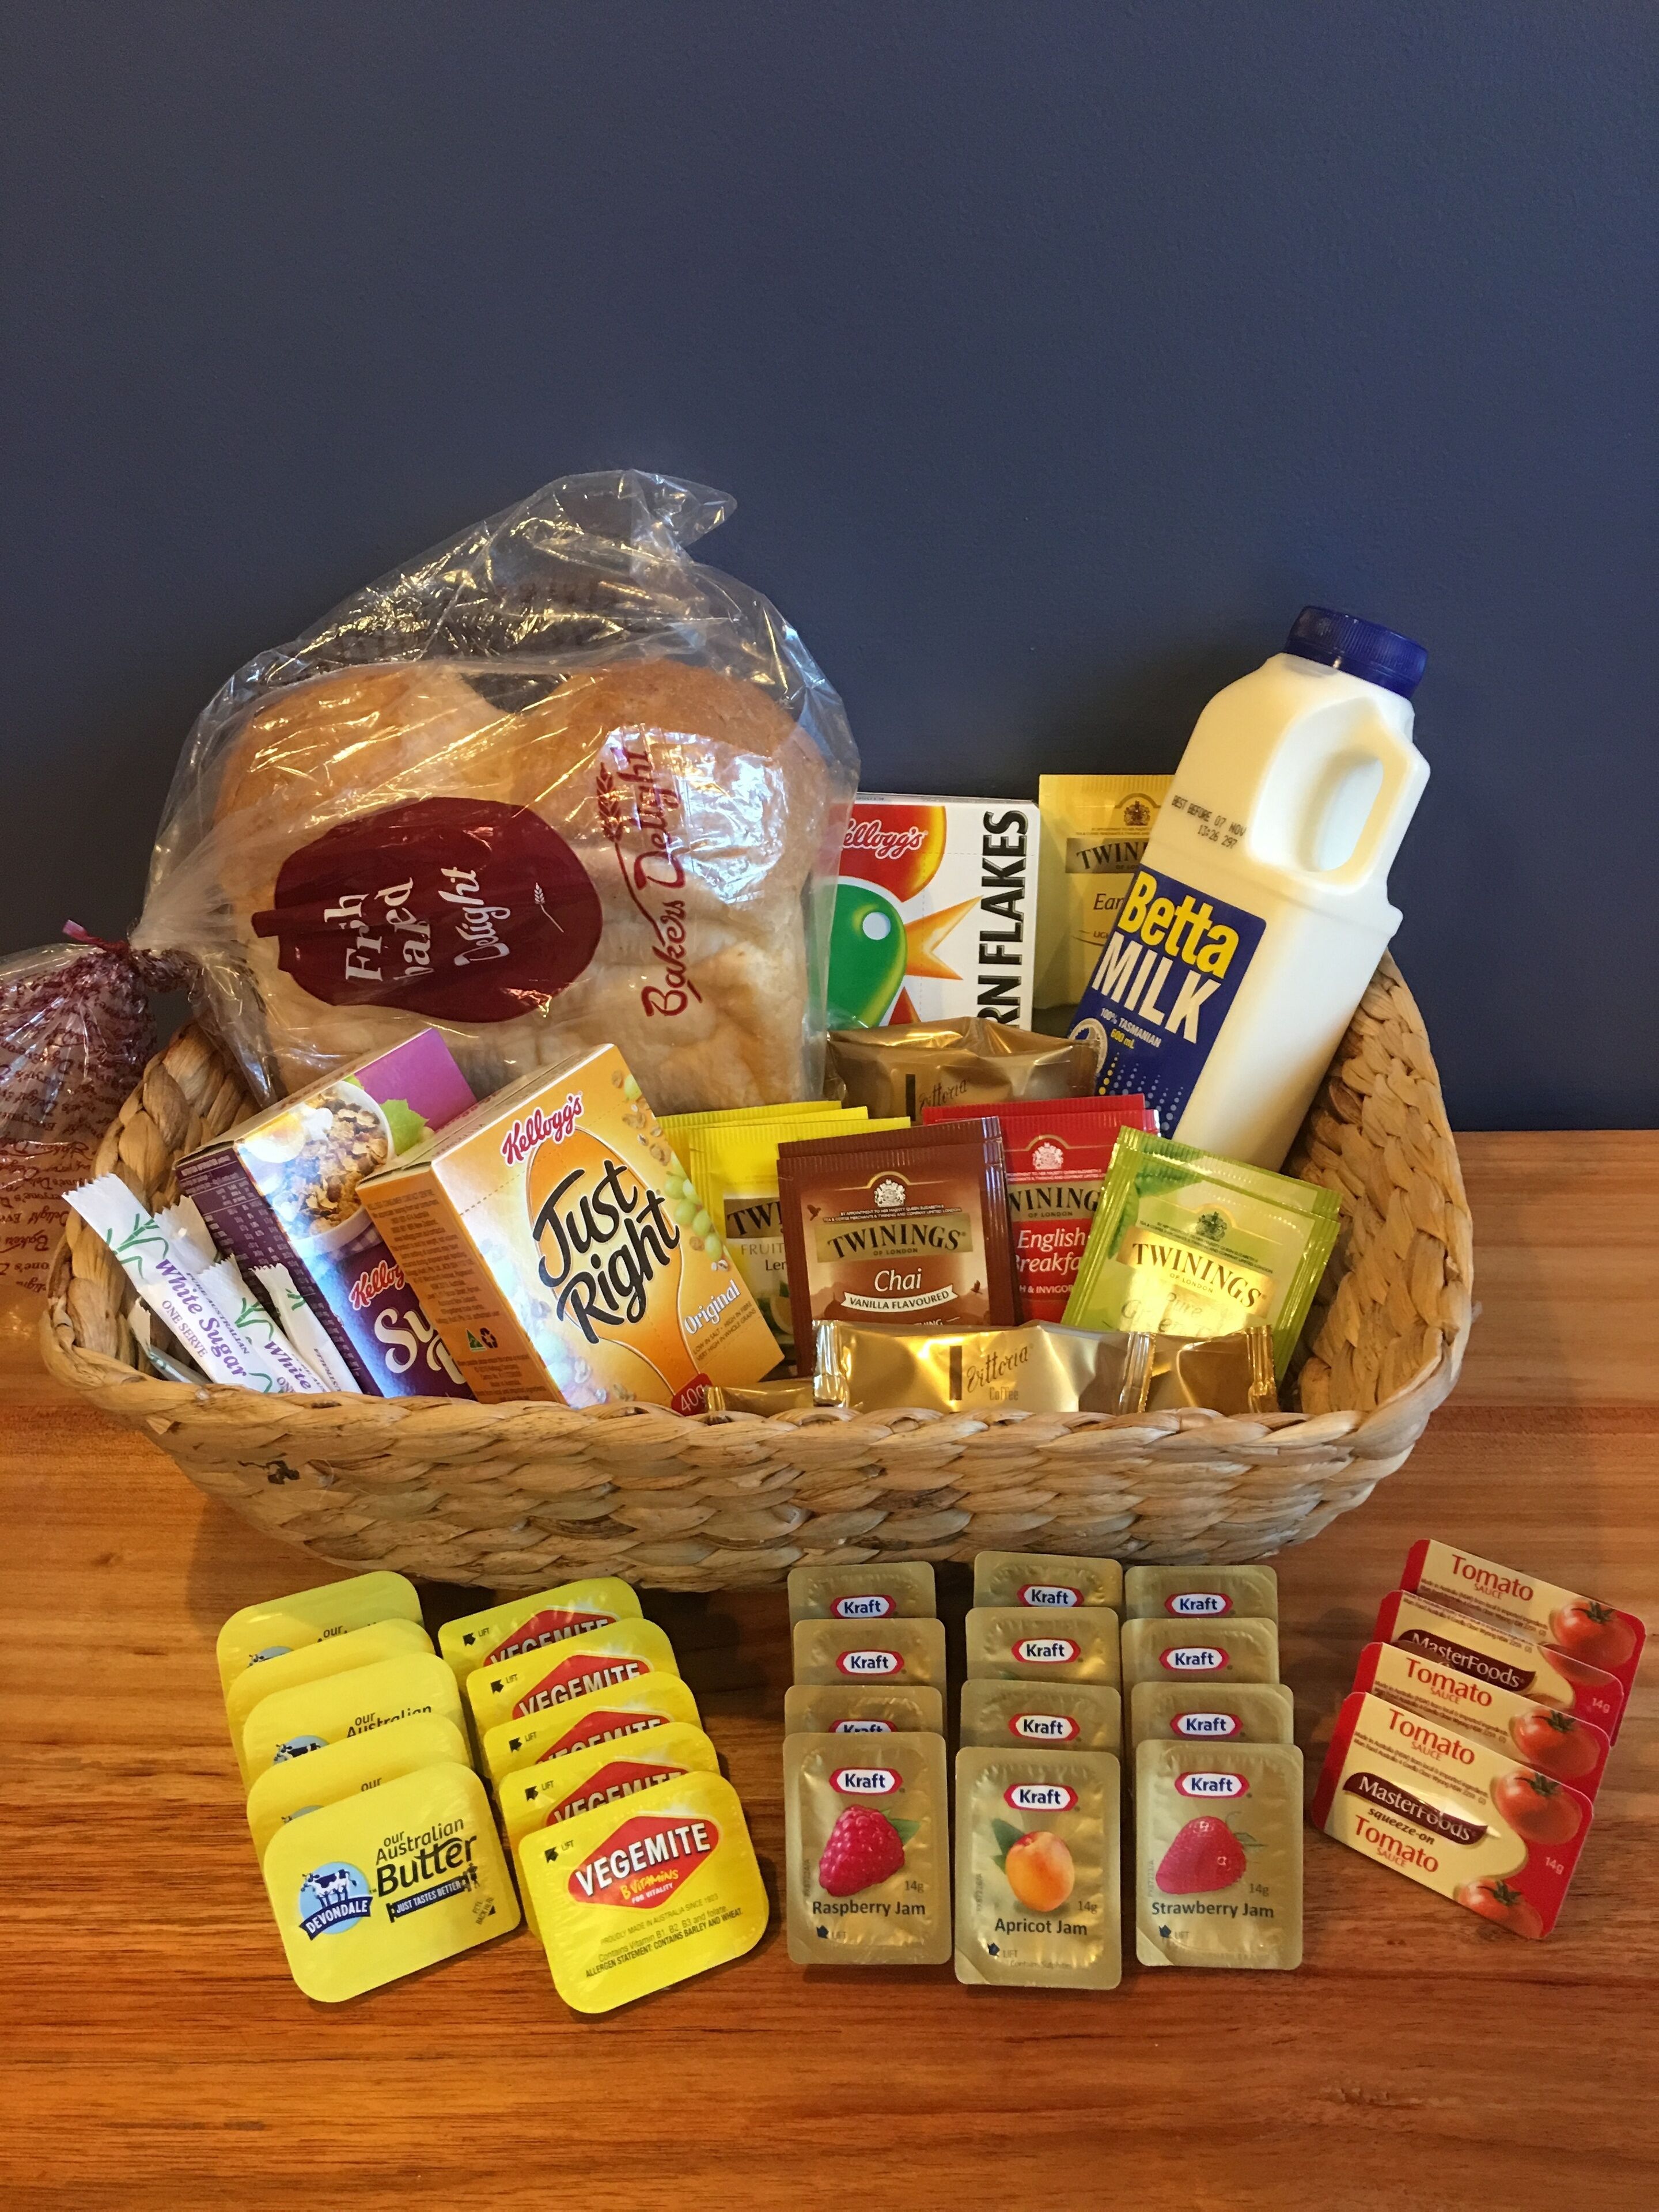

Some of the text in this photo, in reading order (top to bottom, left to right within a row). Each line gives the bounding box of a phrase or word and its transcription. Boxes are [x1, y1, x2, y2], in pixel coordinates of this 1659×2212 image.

[1172, 794, 1186, 809] BEST
[1187, 804, 1213, 823] BEFORE
[1214, 815, 1225, 827] 07
[843, 818, 925, 859] ellogg's
[611, 747, 694, 1016] Bakers Delight
[980, 809, 1029, 965] FLAKES
[438, 865, 510, 966] Delight
[1118, 870, 1240, 979] Betta
[324, 893, 382, 982] Frh
[1092, 933, 1221, 1044] MILK
[1101, 1008, 1162, 1048] 100% TASMANIAN
[501, 1093, 583, 1166] Kellogg's
[533, 1159, 638, 1287] Just
[741, 1242, 785, 1255] FRUIT
[828, 1224, 961, 1258] TWININGS
[1018, 1227, 1086, 1252] English
[557, 1189, 680, 1344] Right
[1132, 1243, 1262, 1308] TWININGS
[874, 1268, 922, 1291] Chai
[1182, 1277, 1213, 1293] LONDON
[683, 1279, 741, 1335] Original
[850, 1290, 949, 1309] VANILLA FLAVOURED
[155, 1258, 250, 1377] White Sugar
[206, 1297, 249, 1355] AUSTRALIAN
[161, 1299, 208, 1358] ONE SERVE
[264, 1340, 312, 1391] White
[967, 1346, 1028, 1393] Vittoria
[990, 1387, 1018, 1400] Coffee
[1451, 1553, 1534, 1601] Tomato
[1031, 1589, 1069, 1605] Kraft
[1474, 1582, 1503, 1600] SAUCE
[844, 1599, 881, 1615] Kraft
[1180, 1597, 1218, 1611] Kraft
[323, 1624, 343, 1639] our
[479, 1627, 490, 1638] LIFT
[1027, 1643, 1065, 1657] Kraft
[1175, 1652, 1214, 1666] Kraft
[1412, 1631, 1521, 1690] MasterFoods
[851, 1655, 889, 1670] Kraft
[506, 1673, 518, 1684] LIFT
[1404, 1657, 1492, 1707] Tomato
[1430, 1687, 1460, 1705] SAUCE
[1591, 1697, 1610, 1714] 14g
[355, 1712, 376, 1727] our
[1024, 1719, 1063, 1736] Kraft
[1186, 1717, 1226, 1732] Kraft
[525, 1732, 537, 1742] LIFT
[1388, 1708, 1475, 1765] Tomato
[1410, 1741, 1441, 1761] SAUCE
[361, 1777, 382, 1792] our
[541, 1780, 554, 1791] LIFT
[845, 1773, 886, 1789] Kraft
[1191, 1777, 1233, 1793] Kraft
[1020, 1789, 1061, 1805] Kraft
[1359, 1777, 1470, 1840] MasterFoods
[1368, 1806, 1435, 1844] squeeze-on
[376, 1818, 464, 1865] Australian
[384, 1831, 405, 1849] our
[560, 1840, 574, 1851] LIFT
[1355, 1815, 1438, 1873] Tomato
[376, 1835, 477, 1897] Butter
[575, 1822, 711, 1897] VEGEMITE
[1376, 1848, 1407, 1868] SAUCE
[1546, 1857, 1564, 1874] 14g
[620, 1885, 631, 1899] B
[631, 1883, 673, 1904] FOR VITALITY
[904, 1880, 924, 1893] 14g
[1249, 1884, 1269, 1897] 14g
[396, 1883, 461, 1914] JUST TASTES BETTER
[1077, 1902, 1098, 1914] 14g
[305, 1899, 368, 1934] DEVONDALE
[812, 1901, 926, 1918] Raspberry Jam
[1152, 1902, 1274, 1918] Strawberry Jam
[600, 1930, 627, 1945] PROUDLY
[627, 1923, 645, 1935] MADE
[646, 1918, 653, 1927] IN
[652, 1906, 684, 1926] AUSTRALIA
[685, 1899, 704, 1911] SINCE
[994, 1918, 1088, 1936] Apricot Jam
[586, 1959, 617, 1978] ALLERGEN
[653, 1931, 683, 1951] CONTAINS
[684, 1921, 707, 1938] BARLEY
[707, 1914, 722, 1927] AND
[598, 1944, 629, 1962] Contains
[630, 1933, 654, 1952] Vitamin
[692, 1911, 706, 1923] and
